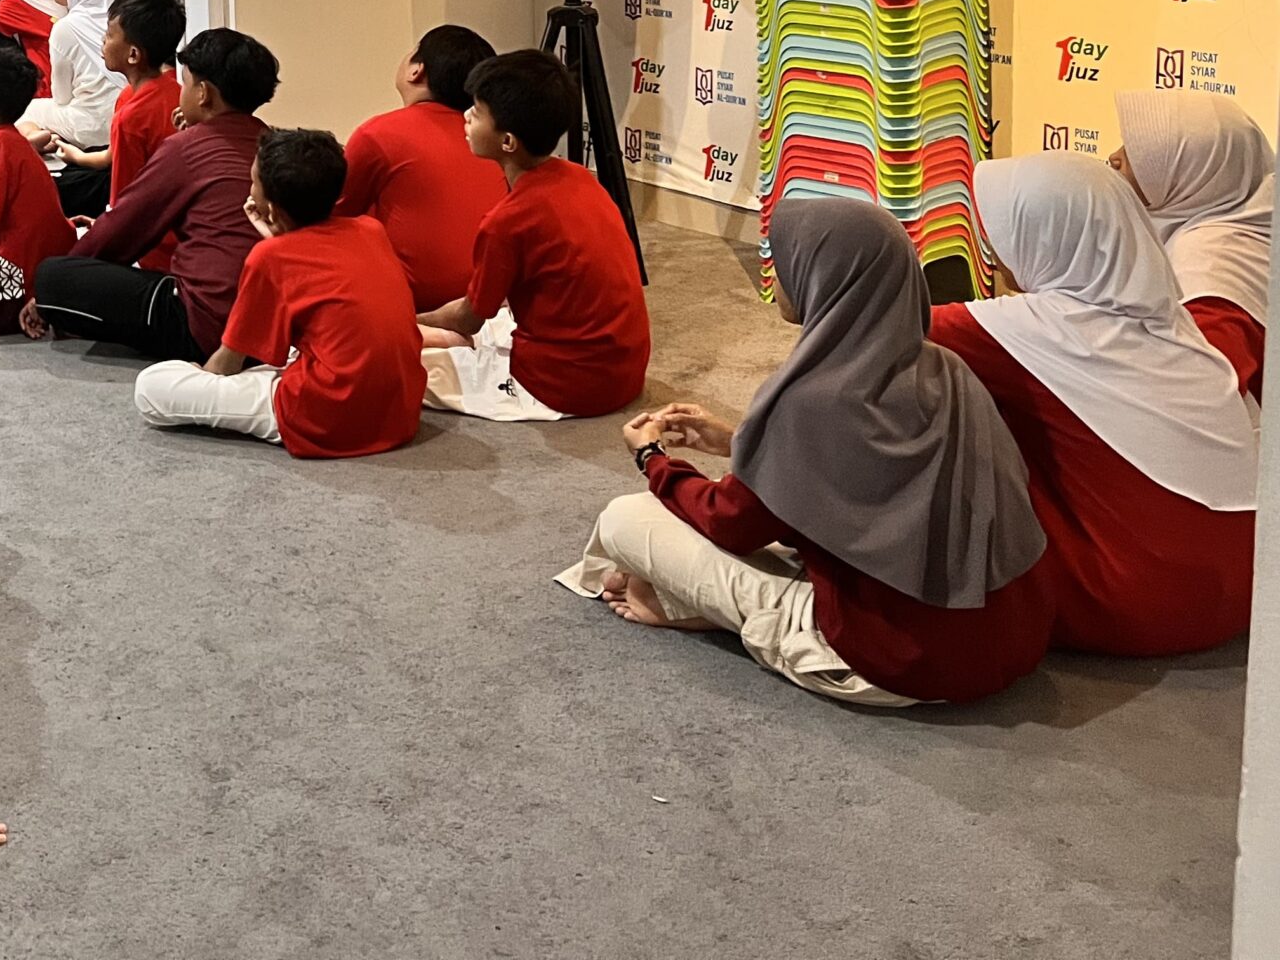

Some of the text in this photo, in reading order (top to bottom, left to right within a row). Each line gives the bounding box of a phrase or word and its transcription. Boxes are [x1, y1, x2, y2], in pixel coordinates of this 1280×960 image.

[710, 16, 733, 31] juz
[1070, 38, 1109, 60] day
[1191, 51, 1218, 63] PUSAT
[640, 59, 665, 77] day
[1066, 63, 1100, 82] juz
[1190, 66, 1216, 78] SYIAR
[639, 79, 660, 94] juz
[1075, 128, 1099, 140] PUSAT
[712, 146, 738, 164] day
[1074, 142, 1097, 154] SYIAR
[709, 166, 733, 182] juz
